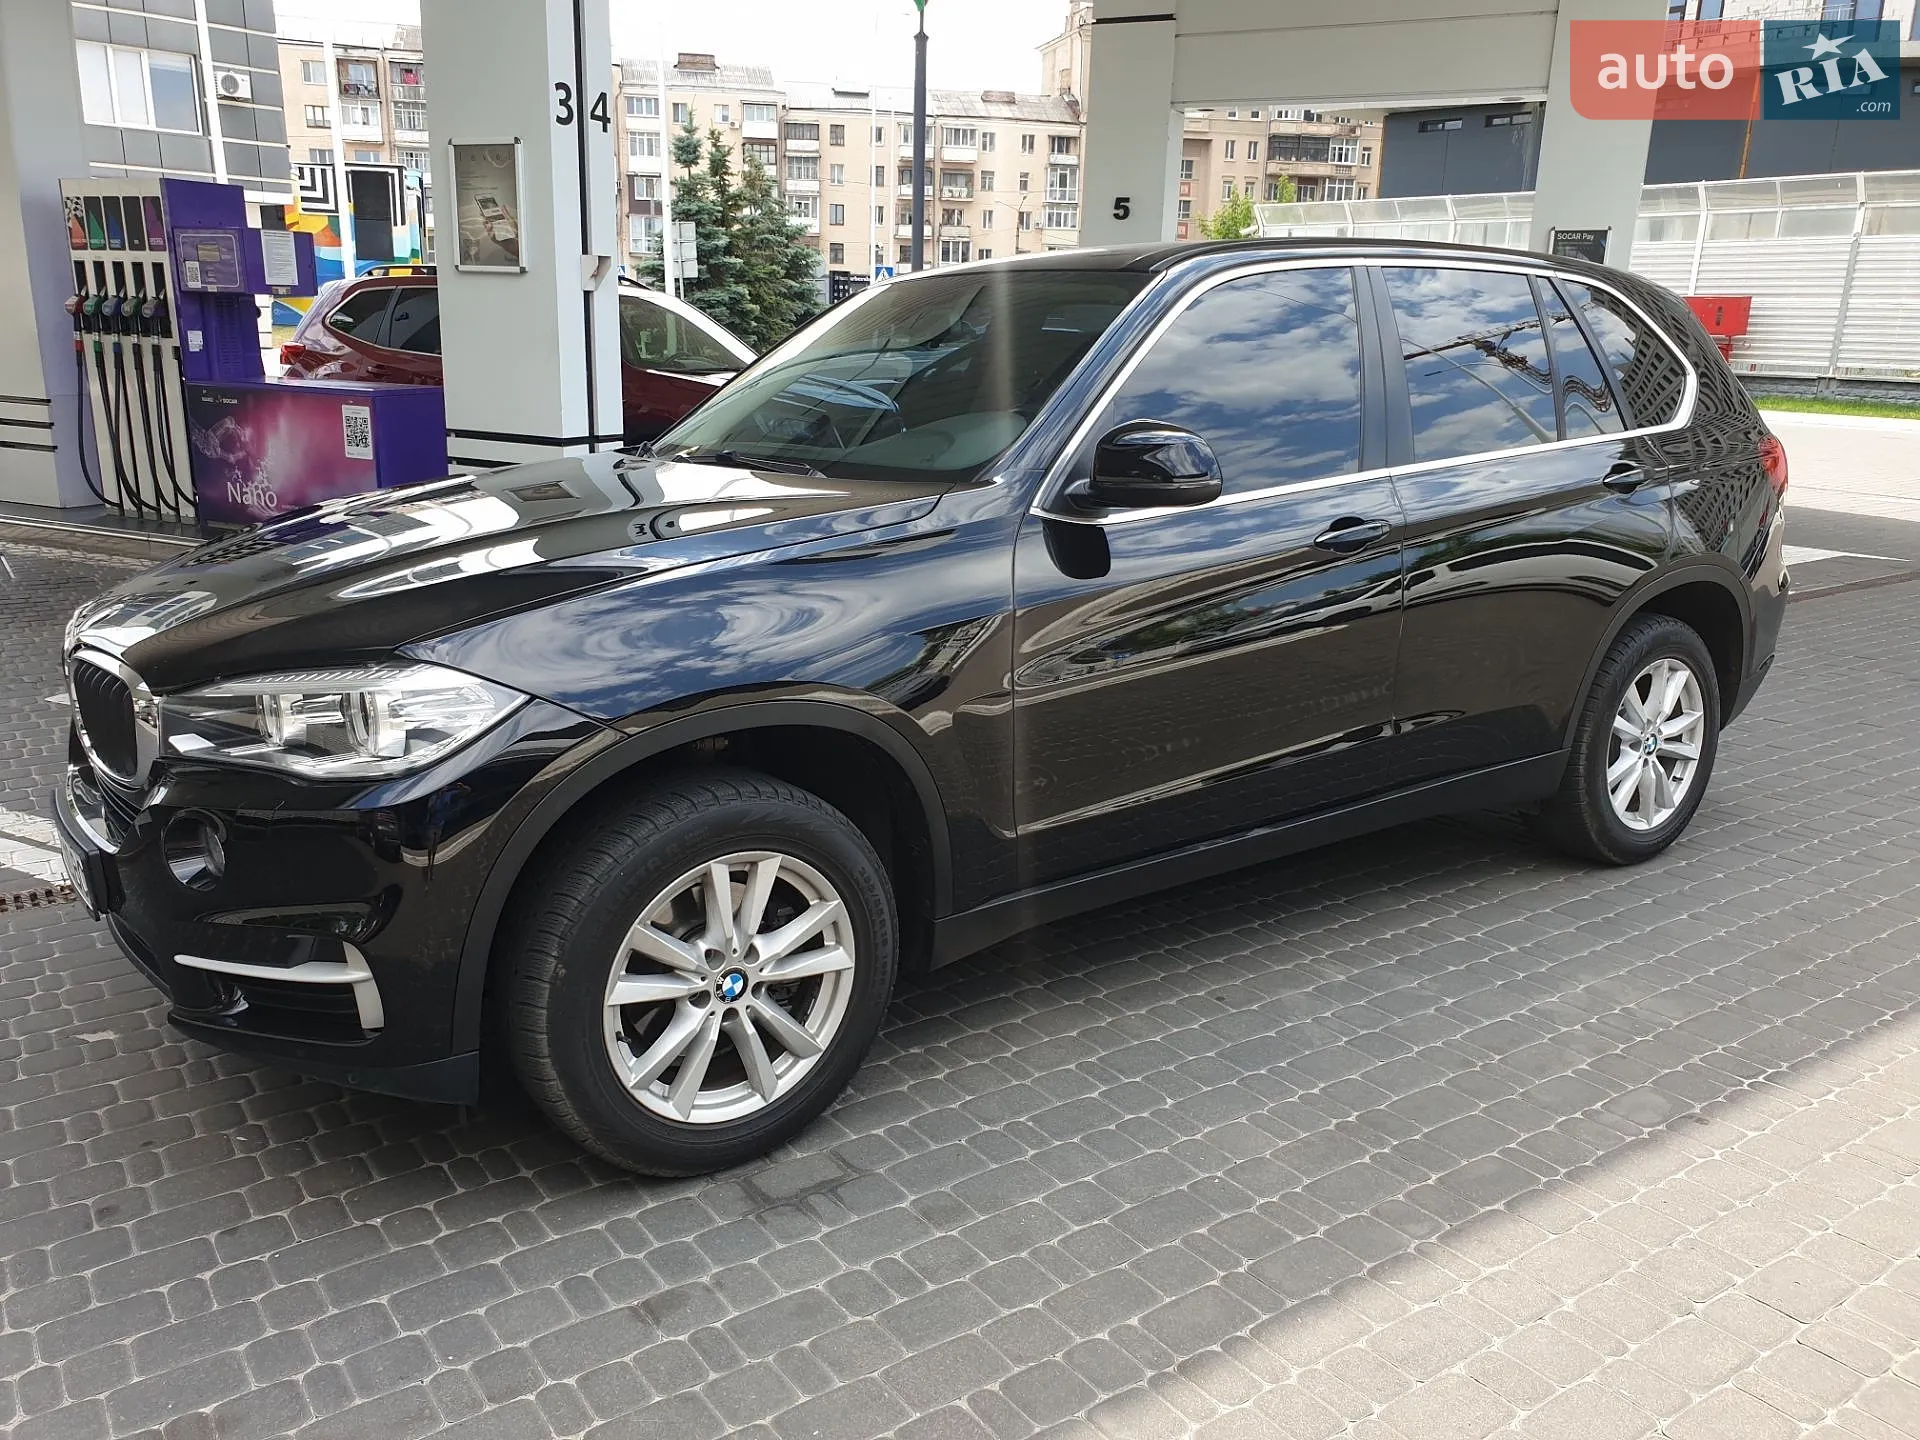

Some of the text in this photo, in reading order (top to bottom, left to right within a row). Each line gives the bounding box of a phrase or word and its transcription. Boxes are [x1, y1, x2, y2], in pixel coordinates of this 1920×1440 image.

[554, 81, 574, 126] 3
[590, 91, 612, 133] 4
[1113, 196, 1130, 221] 5
[1556, 232, 1582, 240] SOCAR
[226, 481, 278, 508] Nano
